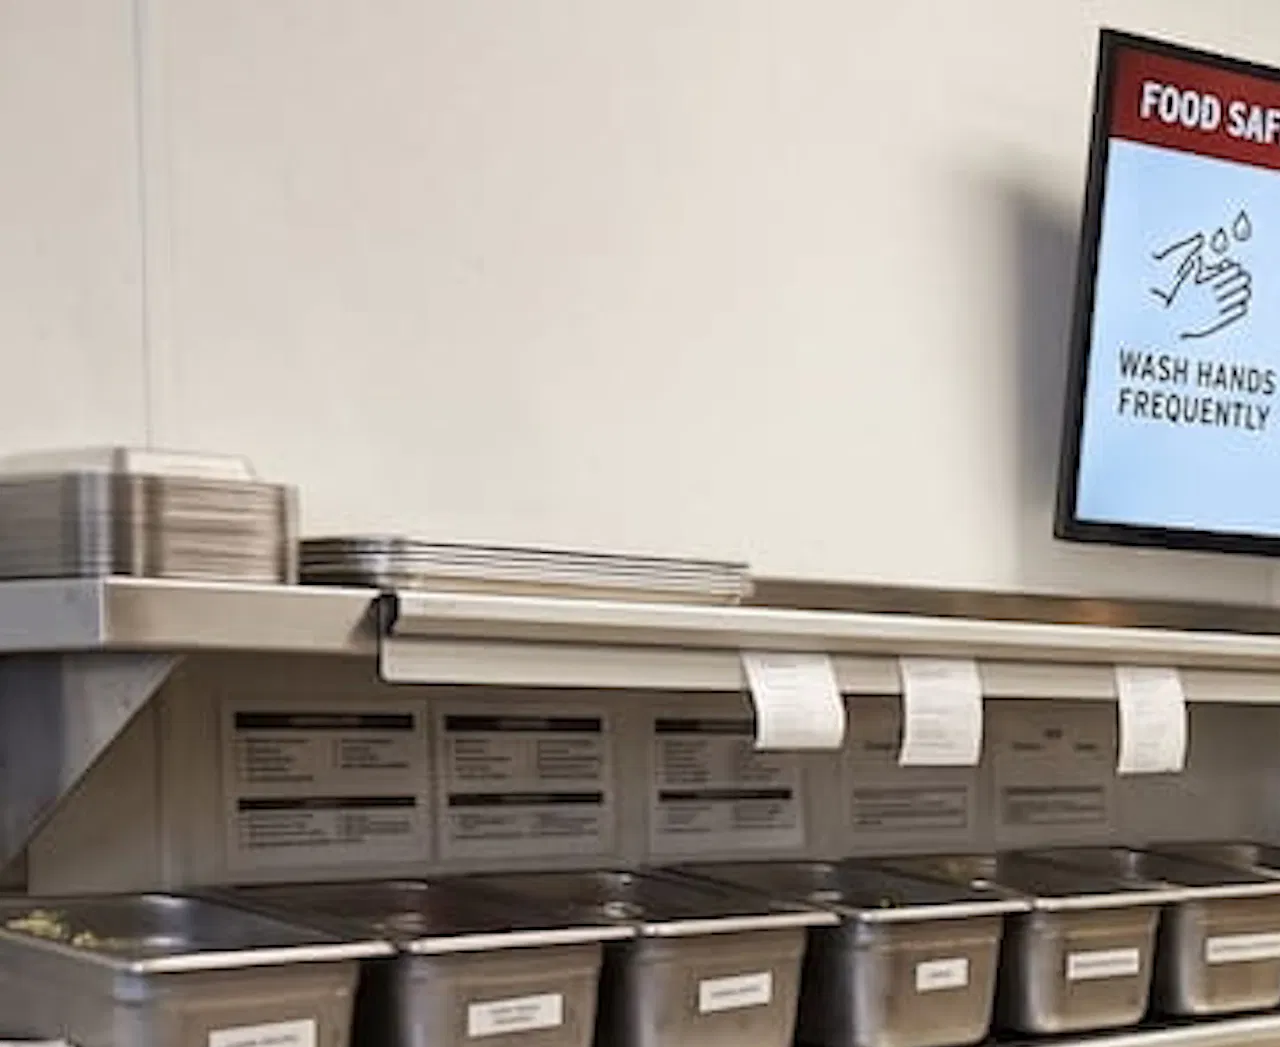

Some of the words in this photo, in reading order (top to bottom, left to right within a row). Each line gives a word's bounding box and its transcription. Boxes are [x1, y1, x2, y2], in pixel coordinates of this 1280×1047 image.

[1139, 80, 1222, 131] FOOD
[1118, 349, 1188, 384] WASH
[1197, 359, 1278, 395] HANDS
[1117, 386, 1271, 431] FREQUENTLY
